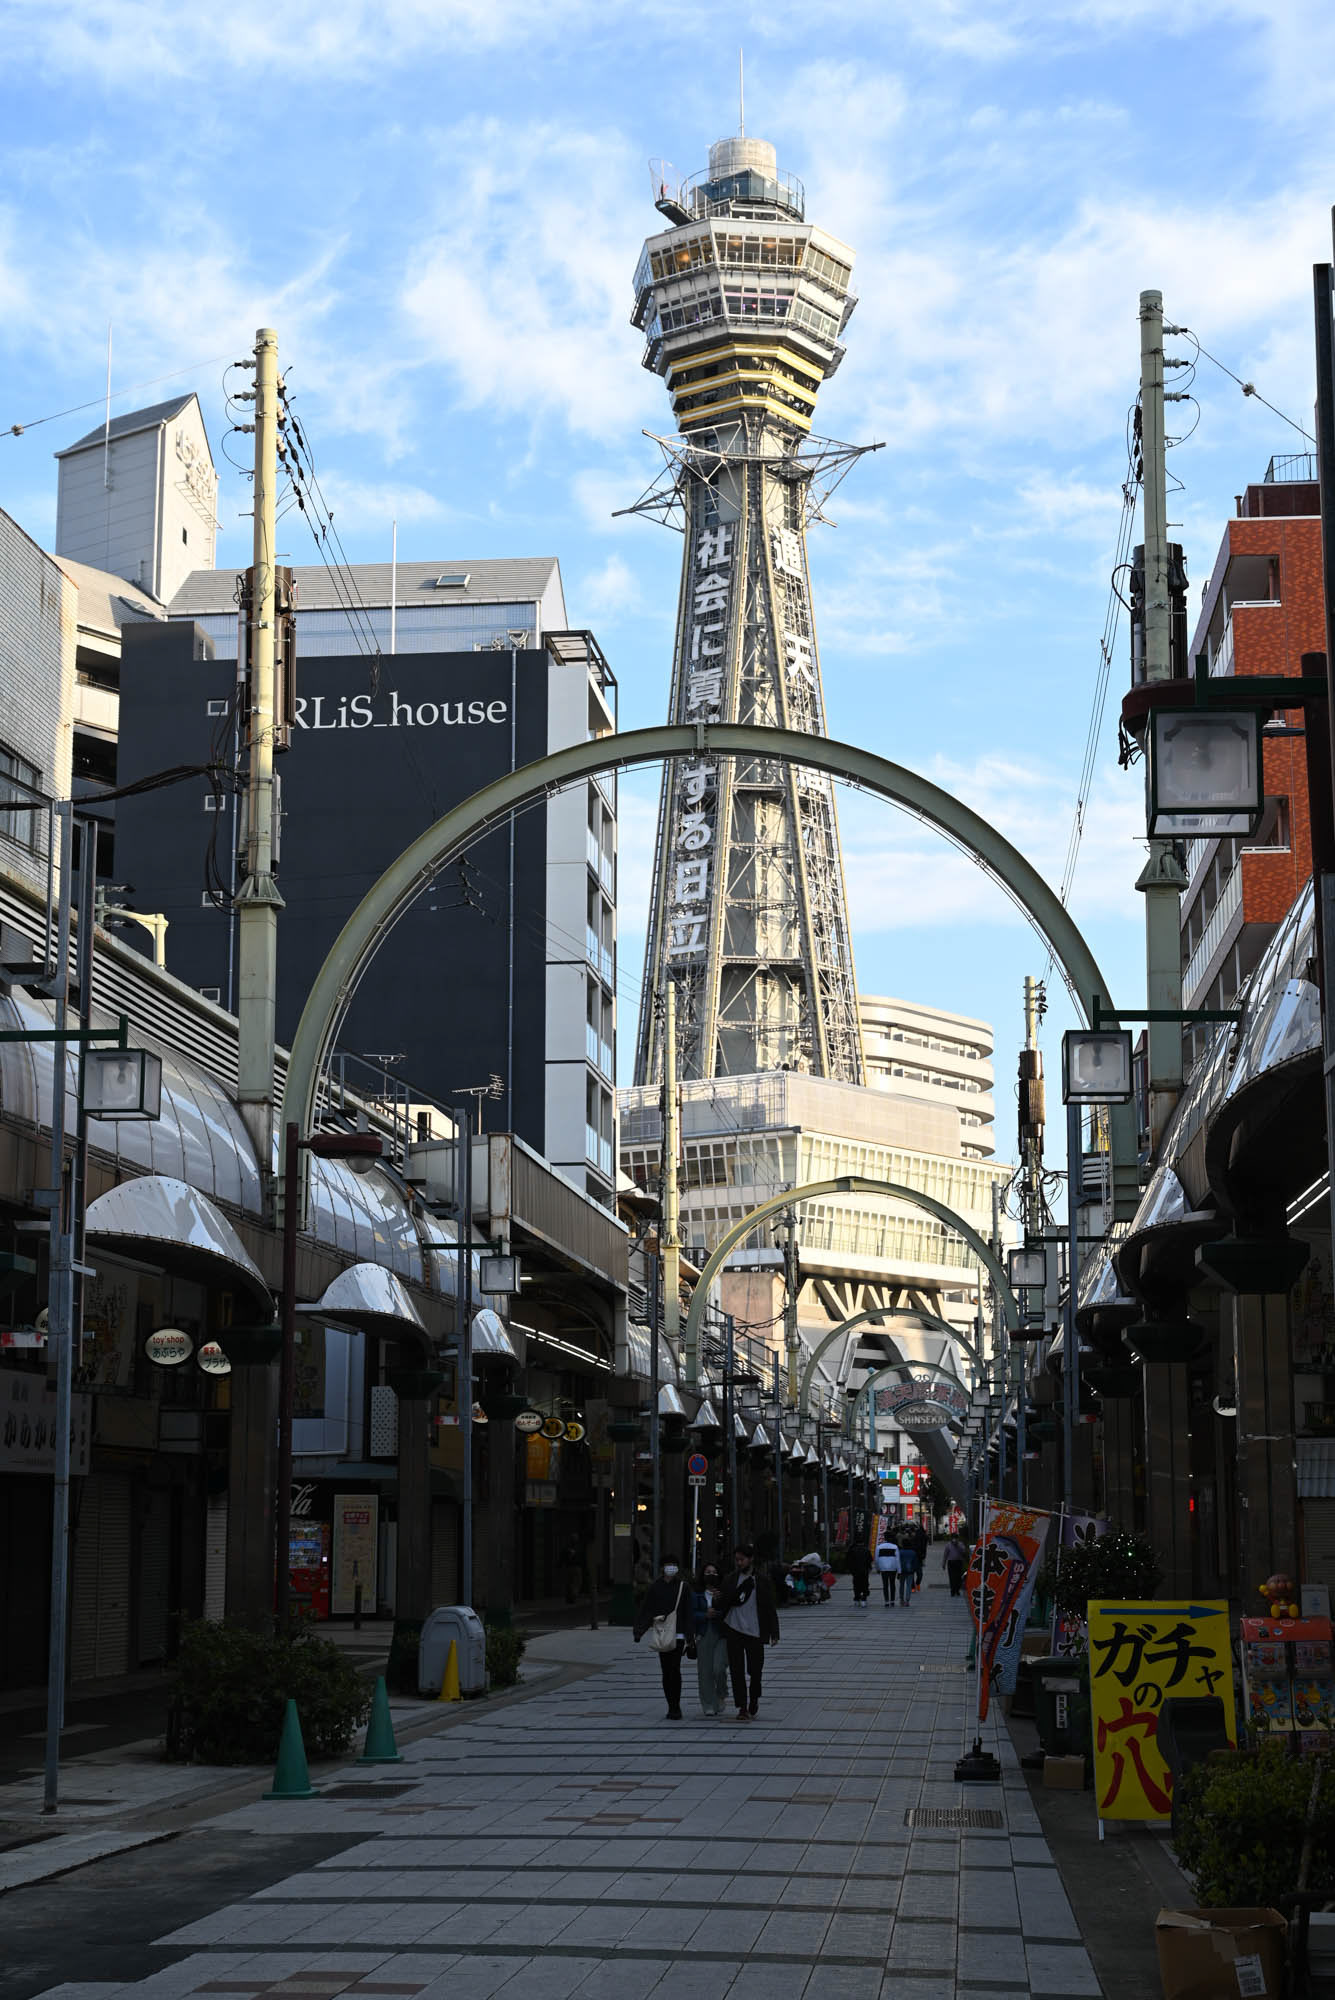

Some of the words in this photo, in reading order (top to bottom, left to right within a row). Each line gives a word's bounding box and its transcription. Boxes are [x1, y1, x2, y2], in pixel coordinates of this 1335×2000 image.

[671, 525, 733, 954] 社会に貢する日立
[152, 1347, 186, 1358] あぶらや
[898, 1414, 947, 1425] SHINSEKAI
[1092, 1622, 1225, 1693] ガチャ
[1133, 1682, 1162, 1708] の
